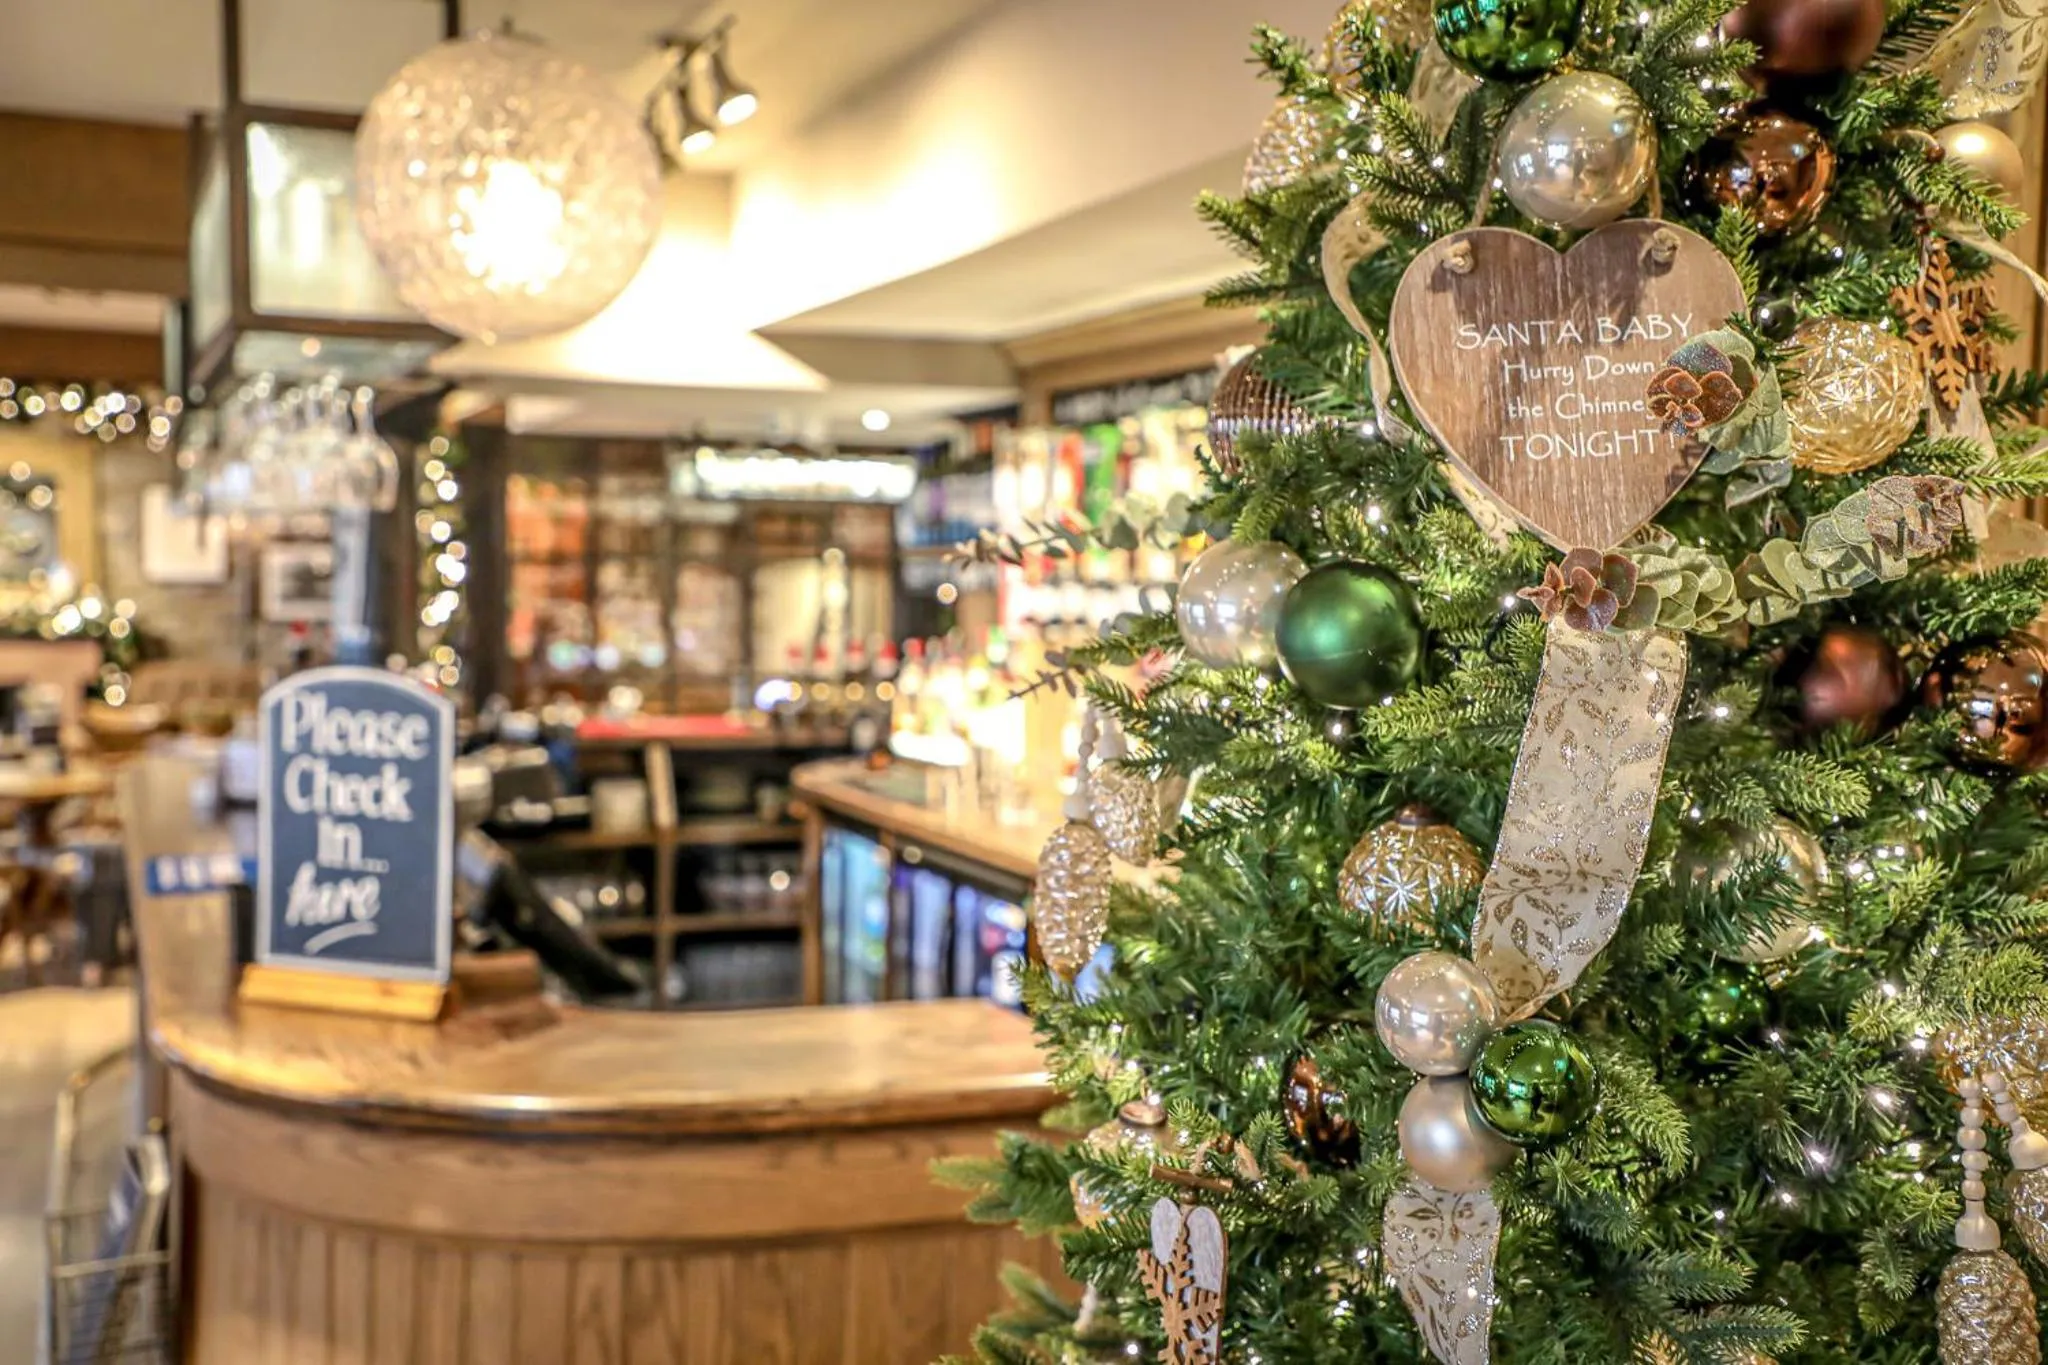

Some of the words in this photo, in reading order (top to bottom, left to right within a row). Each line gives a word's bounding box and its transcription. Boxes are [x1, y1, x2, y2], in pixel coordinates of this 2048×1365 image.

[1456, 319, 1583, 350] SANTA
[1597, 313, 1694, 343] BABY
[1503, 358, 1574, 387] Hurry
[1584, 354, 1655, 381] Down
[1507, 398, 1544, 420] the
[1555, 392, 1657, 421] Chimne
[281, 690, 429, 758] Please
[284, 753, 414, 822] Check
[285, 861, 382, 928] here
